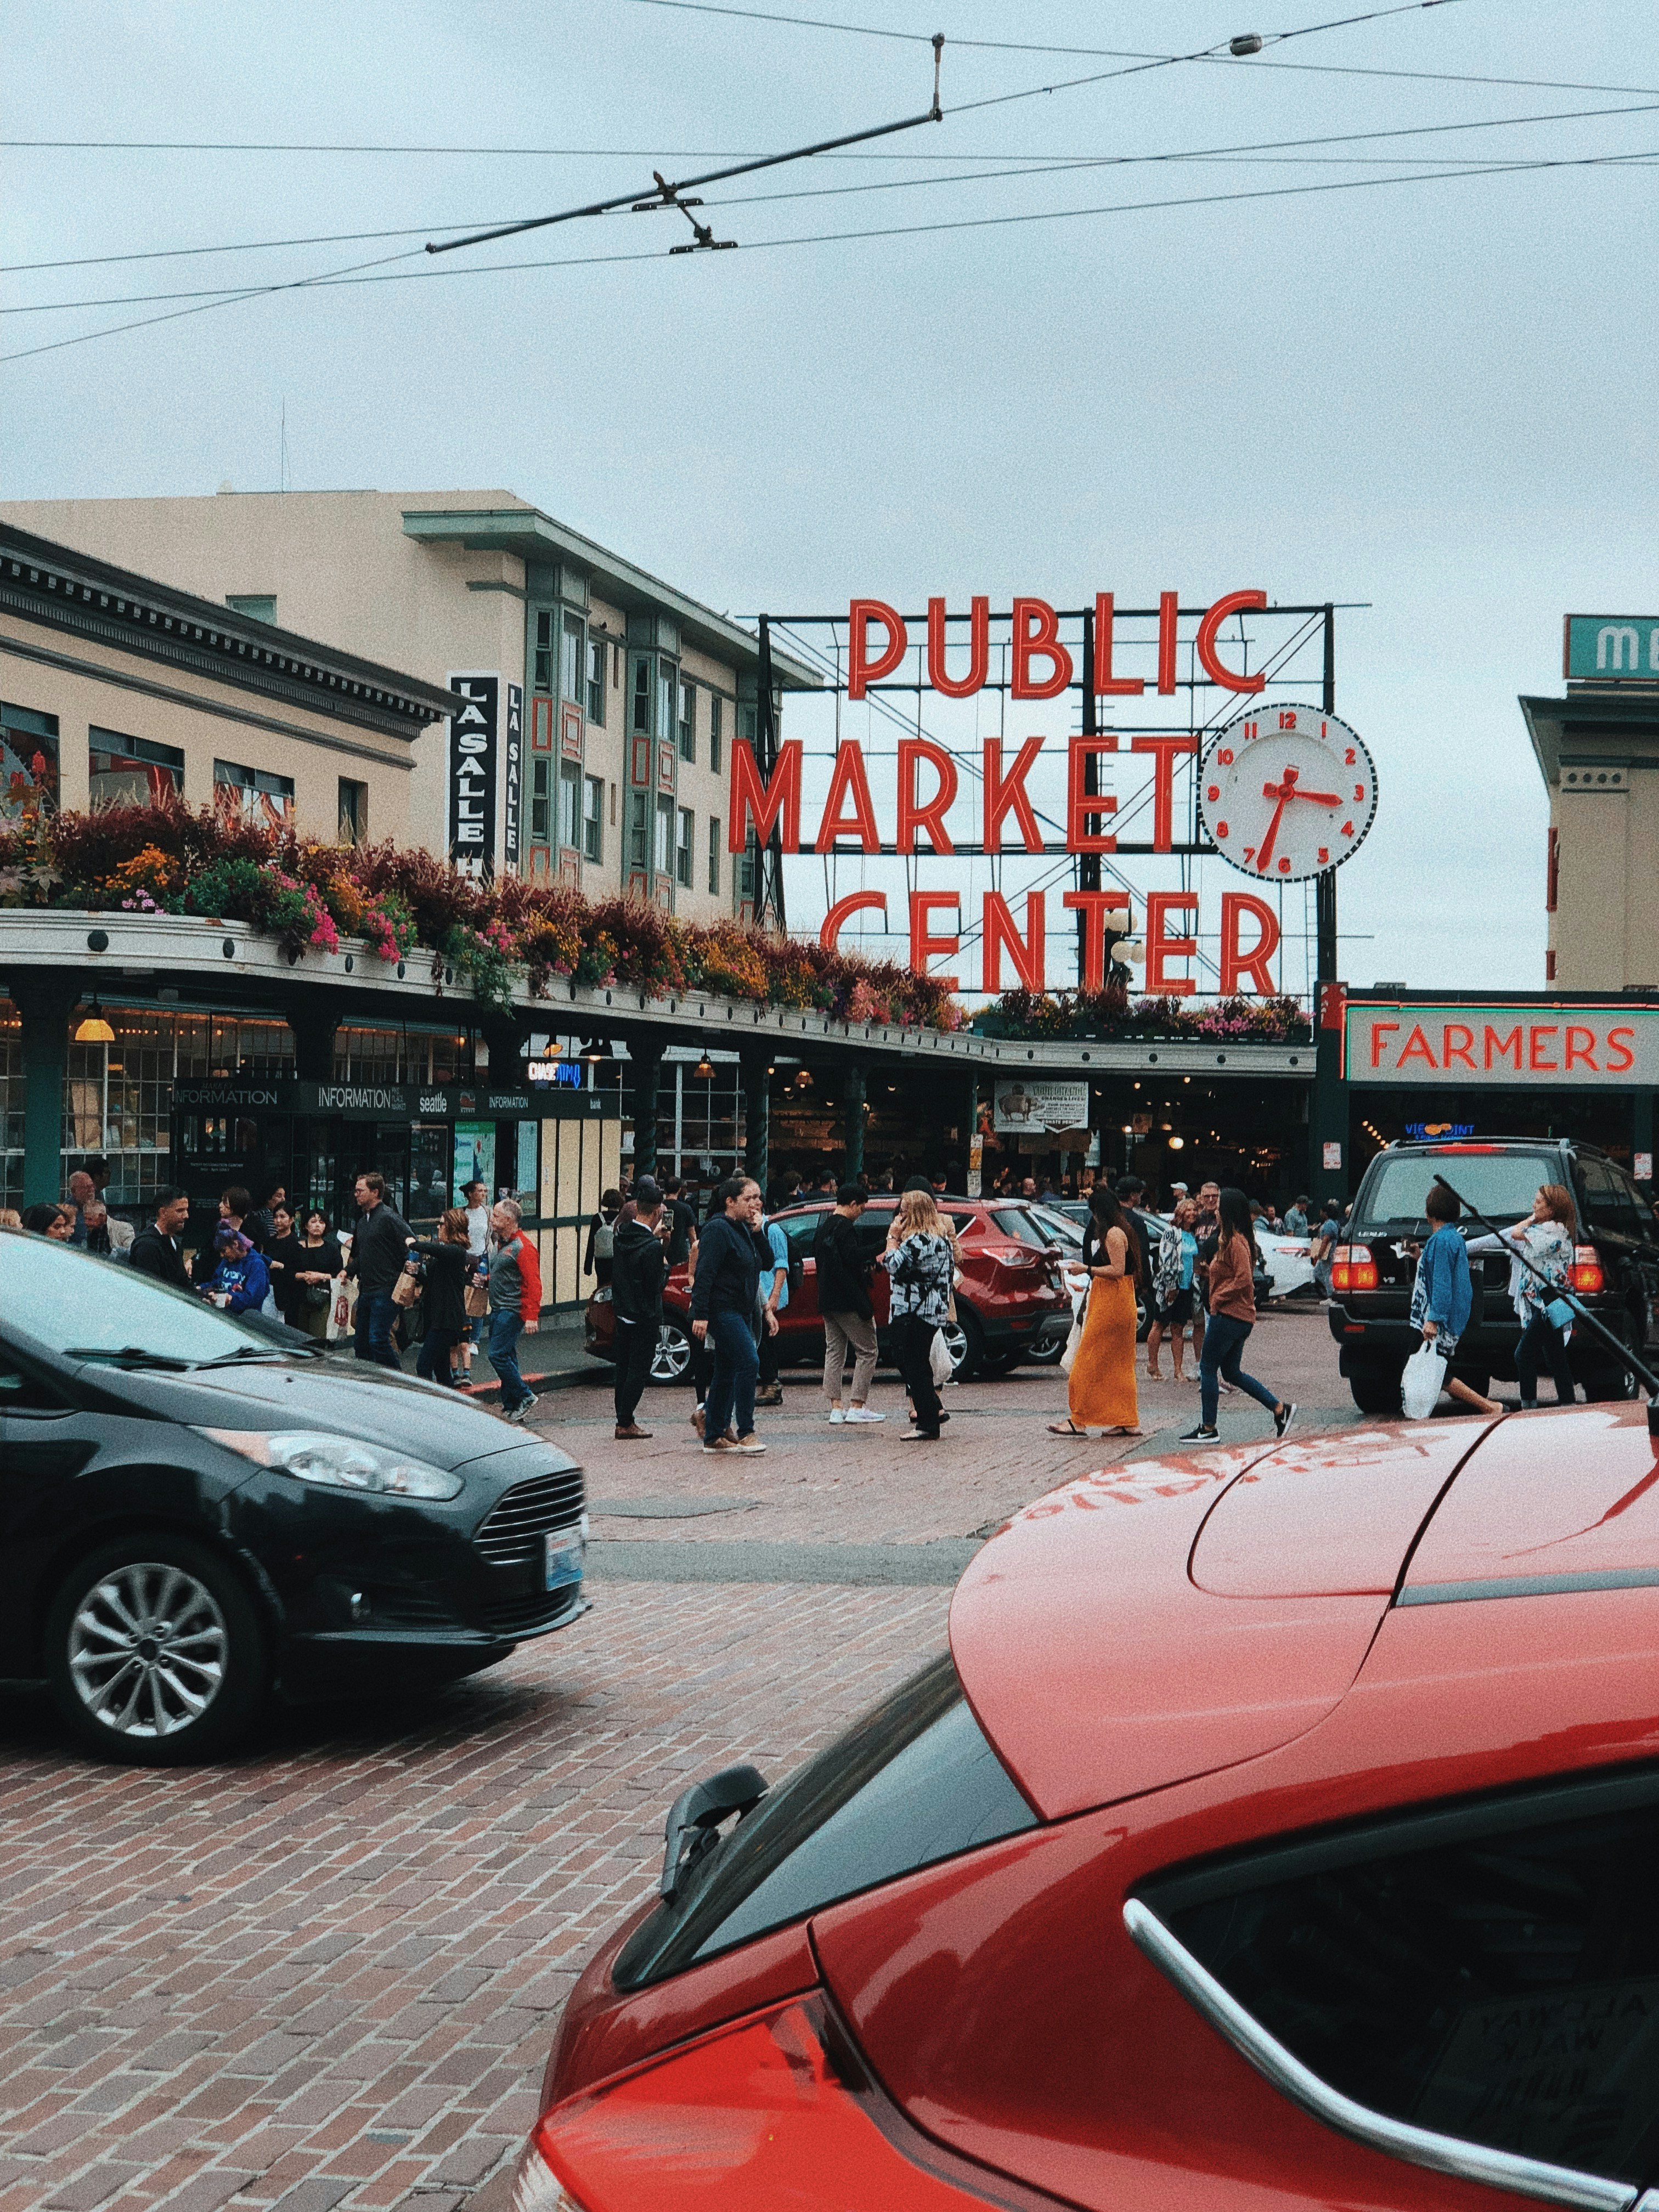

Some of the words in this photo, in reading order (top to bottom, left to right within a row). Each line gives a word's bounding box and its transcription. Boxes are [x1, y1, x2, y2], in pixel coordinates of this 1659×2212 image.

[848, 590, 1267, 700] PUBLIC
[1279, 712, 1297, 729] 12
[1244, 722, 1257, 739] 11
[1321, 721, 1327, 738] 1
[1217, 748, 1234, 765] 10
[1345, 748, 1356, 765] 2
[456, 733, 488, 843] SALLE
[729, 736, 1198, 855] MARKET
[1207, 785, 1220, 802] 9
[1353, 784, 1364, 802] 3
[507, 744, 518, 850] SALLE
[1216, 821, 1229, 838] 8
[1341, 821, 1355, 838] 4
[1243, 847, 1255, 864] 7
[1317, 847, 1329, 864] 5
[1278, 856, 1291, 873] 6
[820, 891, 1280, 997] CENTER
[1370, 1023, 1636, 1071] FARMERS
[528, 1062, 558, 1081] CHASE
[556, 1063, 573, 1081] ATM
[319, 1087, 391, 1109] INFORMATION
[420, 1091, 447, 1113] seattle
[489, 1096, 528, 1109] INFORMATION
[1405, 1122, 1475, 1135] VIEINT
